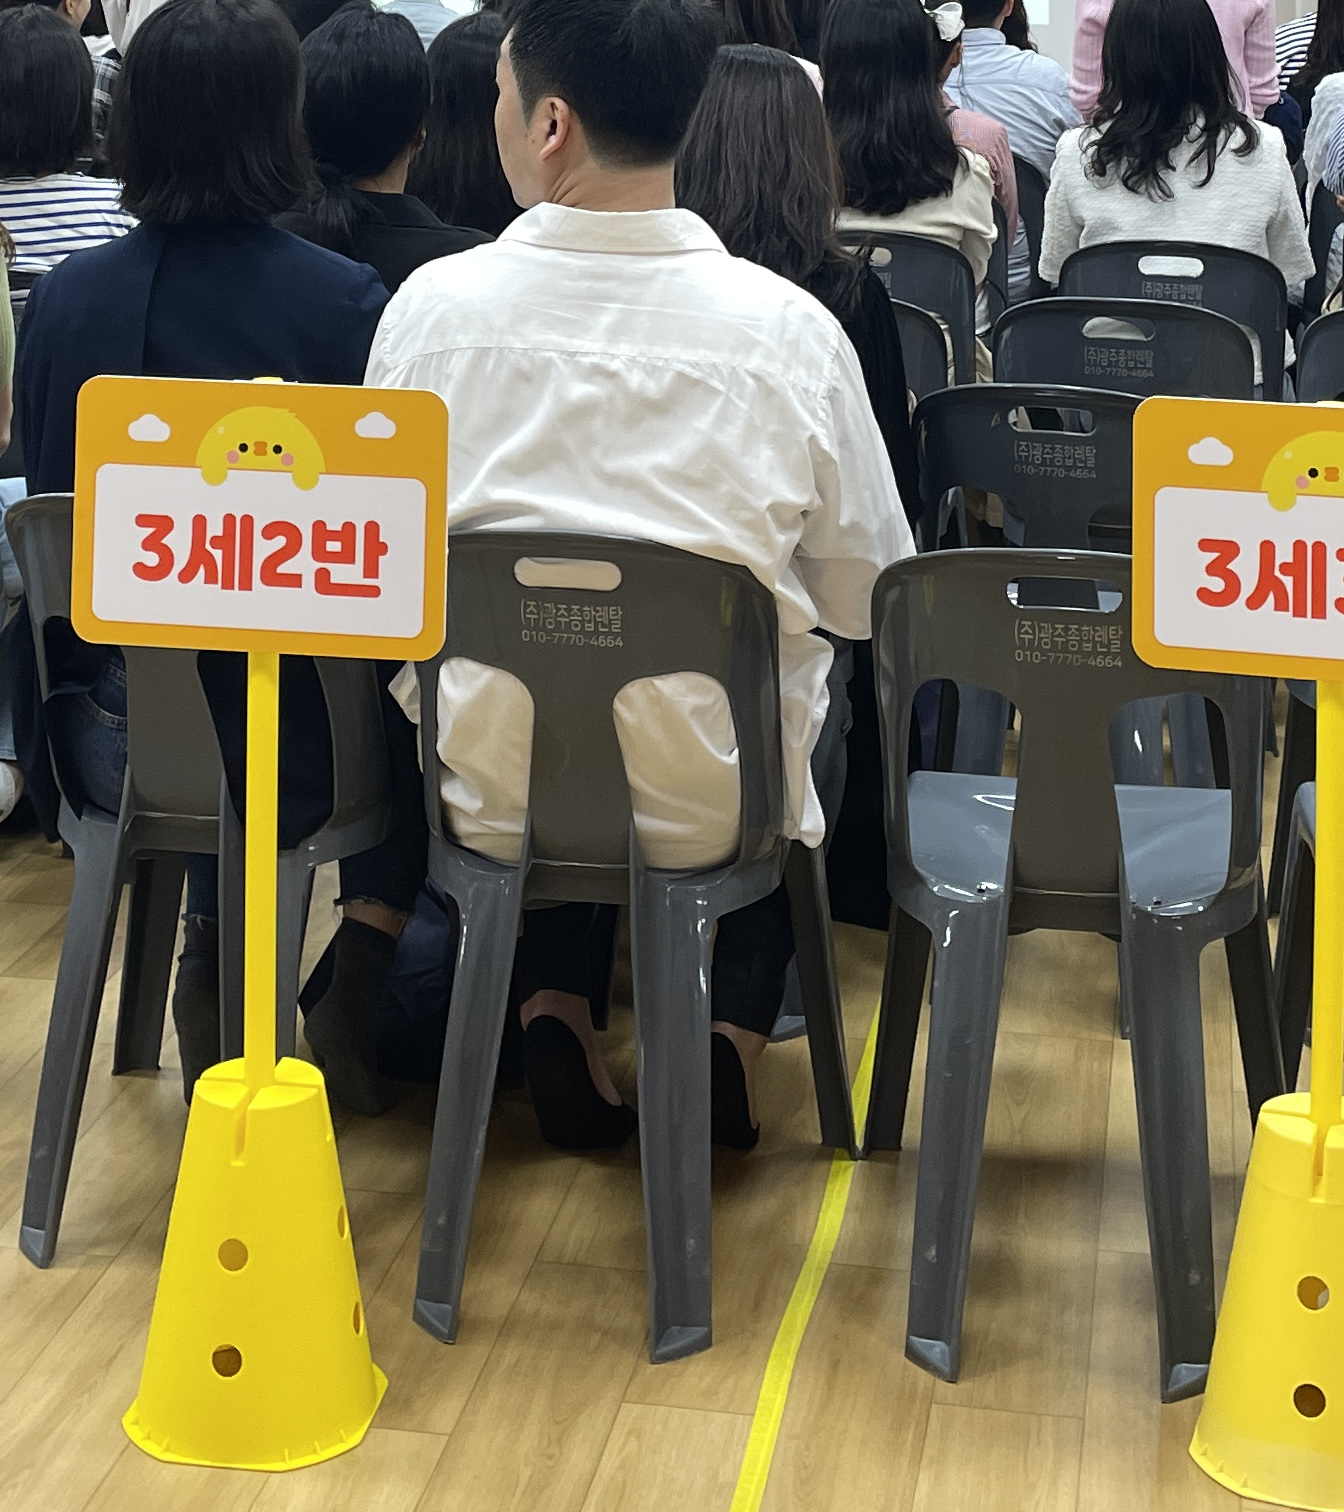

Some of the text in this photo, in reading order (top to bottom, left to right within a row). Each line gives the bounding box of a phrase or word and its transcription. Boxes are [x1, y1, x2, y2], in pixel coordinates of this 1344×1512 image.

[1014, 440, 1096, 467] (주)광주종합렌탈
[1014, 464, 1096, 479] 010-7770-4664
[131, 512, 389, 599] 3세2반
[521, 598, 623, 633] (주)광주종합렌탈
[521, 629, 624, 648] 010-7770-4664
[1015, 619, 1123, 652] (주)광주종합렌탈
[1015, 650, 1123, 667] 010-7770-4664
